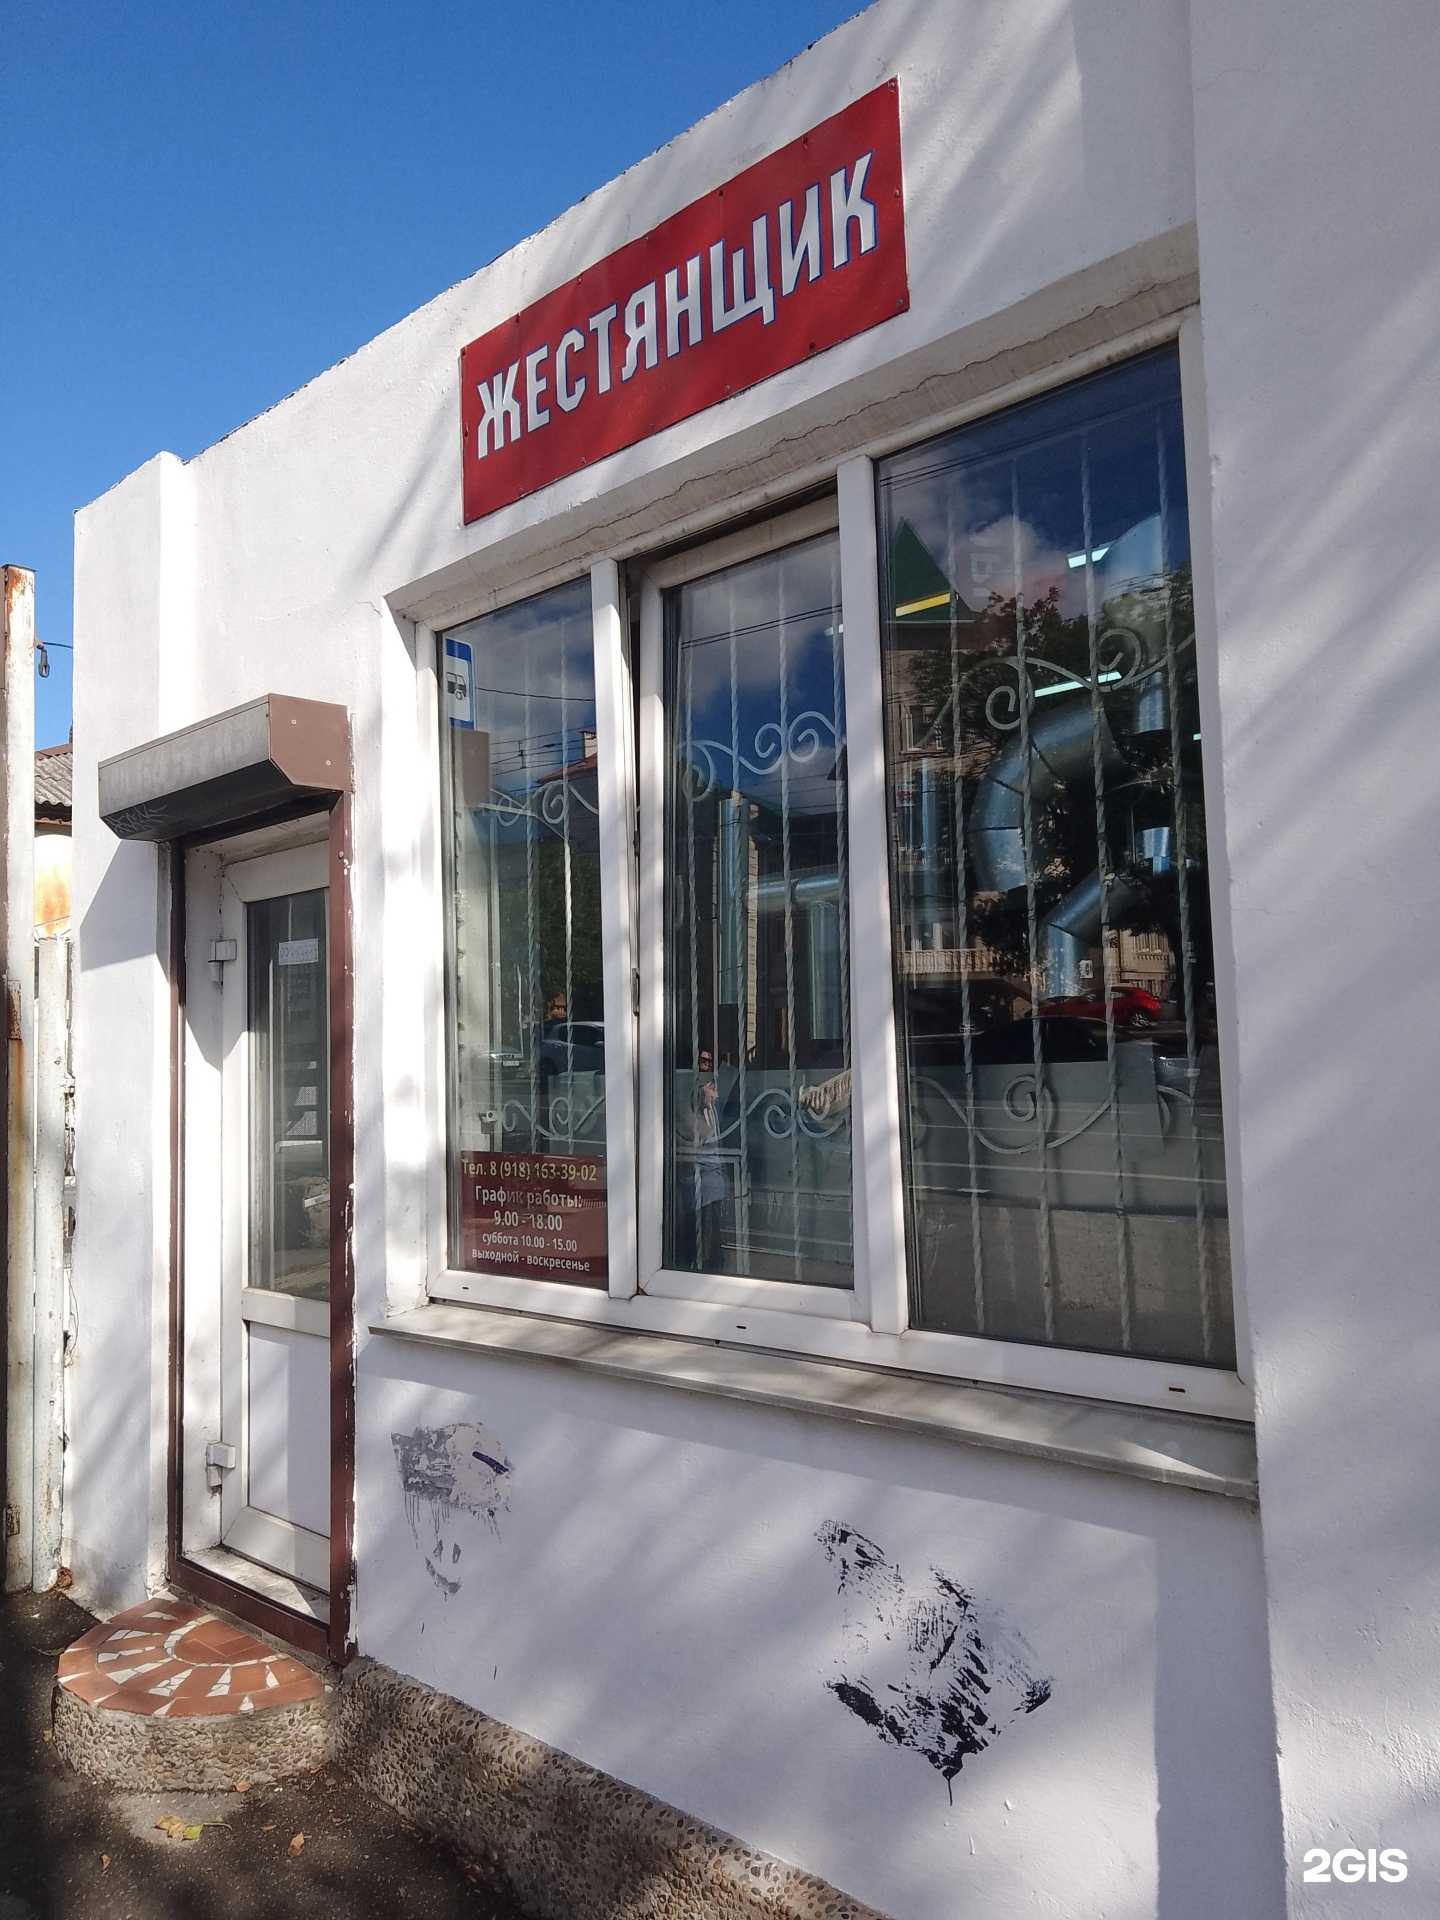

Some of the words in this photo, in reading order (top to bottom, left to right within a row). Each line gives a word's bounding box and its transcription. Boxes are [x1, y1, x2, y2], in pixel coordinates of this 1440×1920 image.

[476, 151, 877, 461] ЖЕСТЯНЩИК
[462, 1158, 487, 1176] Тел.
[490, 1162, 497, 1177] 8
[500, 1161, 531, 1181] (918)
[534, 1163, 597, 1182] 163-39-02
[475, 1185, 524, 1207] График
[527, 1189, 583, 1209] работы:
[494, 1210, 519, 1227] 9.00
[529, 1213, 563, 1231] 18.00
[482, 1231, 519, 1247] суббота
[521, 1235, 545, 1249] 10.00
[553, 1238, 578, 1252] 15.00
[472, 1249, 519, 1264] выходной
[527, 1255, 590, 1272] воскресенье
